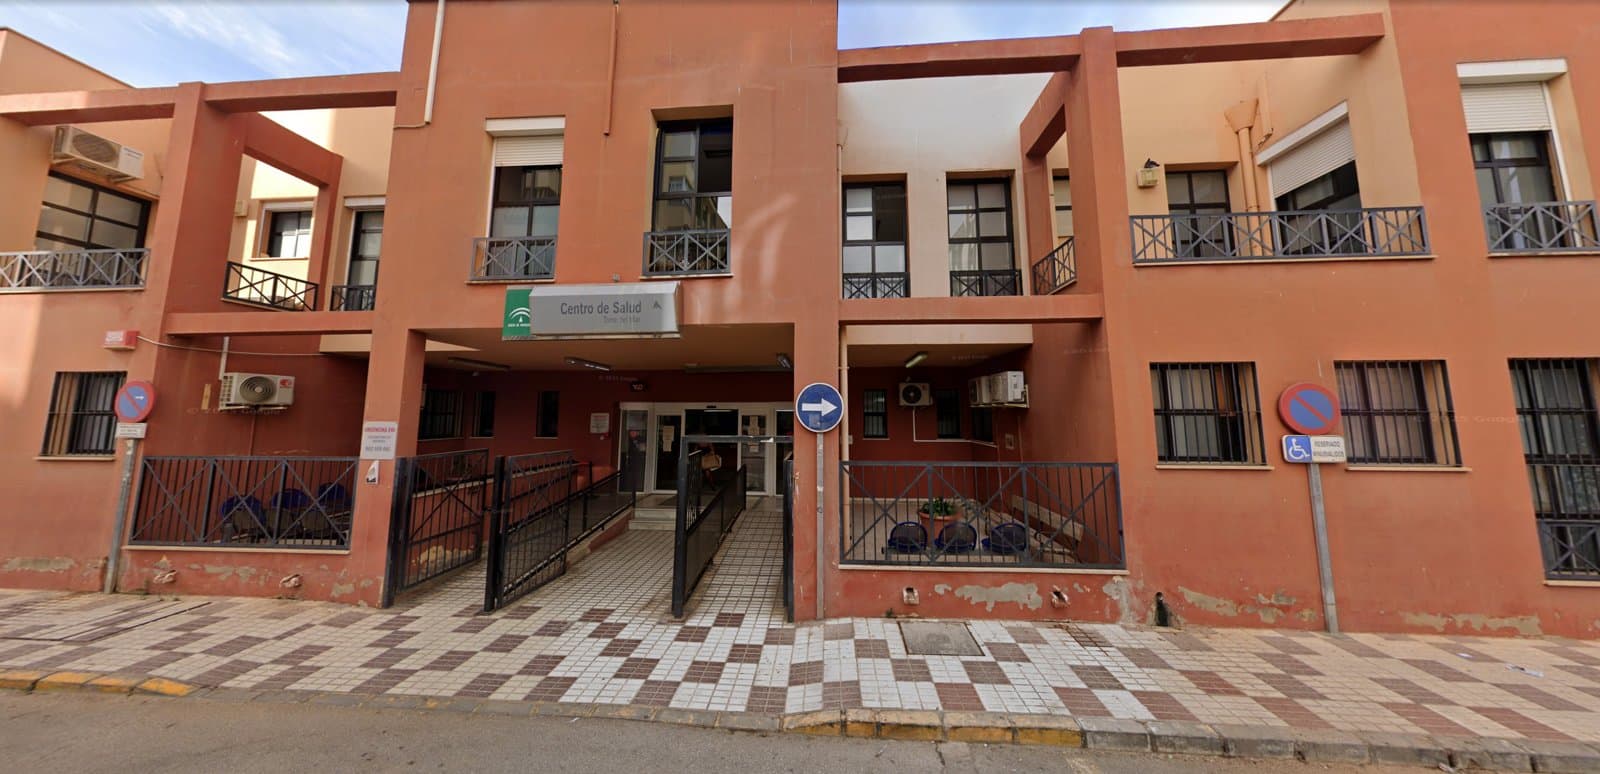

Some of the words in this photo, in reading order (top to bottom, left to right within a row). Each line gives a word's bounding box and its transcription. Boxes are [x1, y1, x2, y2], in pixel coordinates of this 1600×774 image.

[560, 302, 594, 315] Centro
[597, 302, 609, 314] de
[613, 301, 642, 314] Salud
